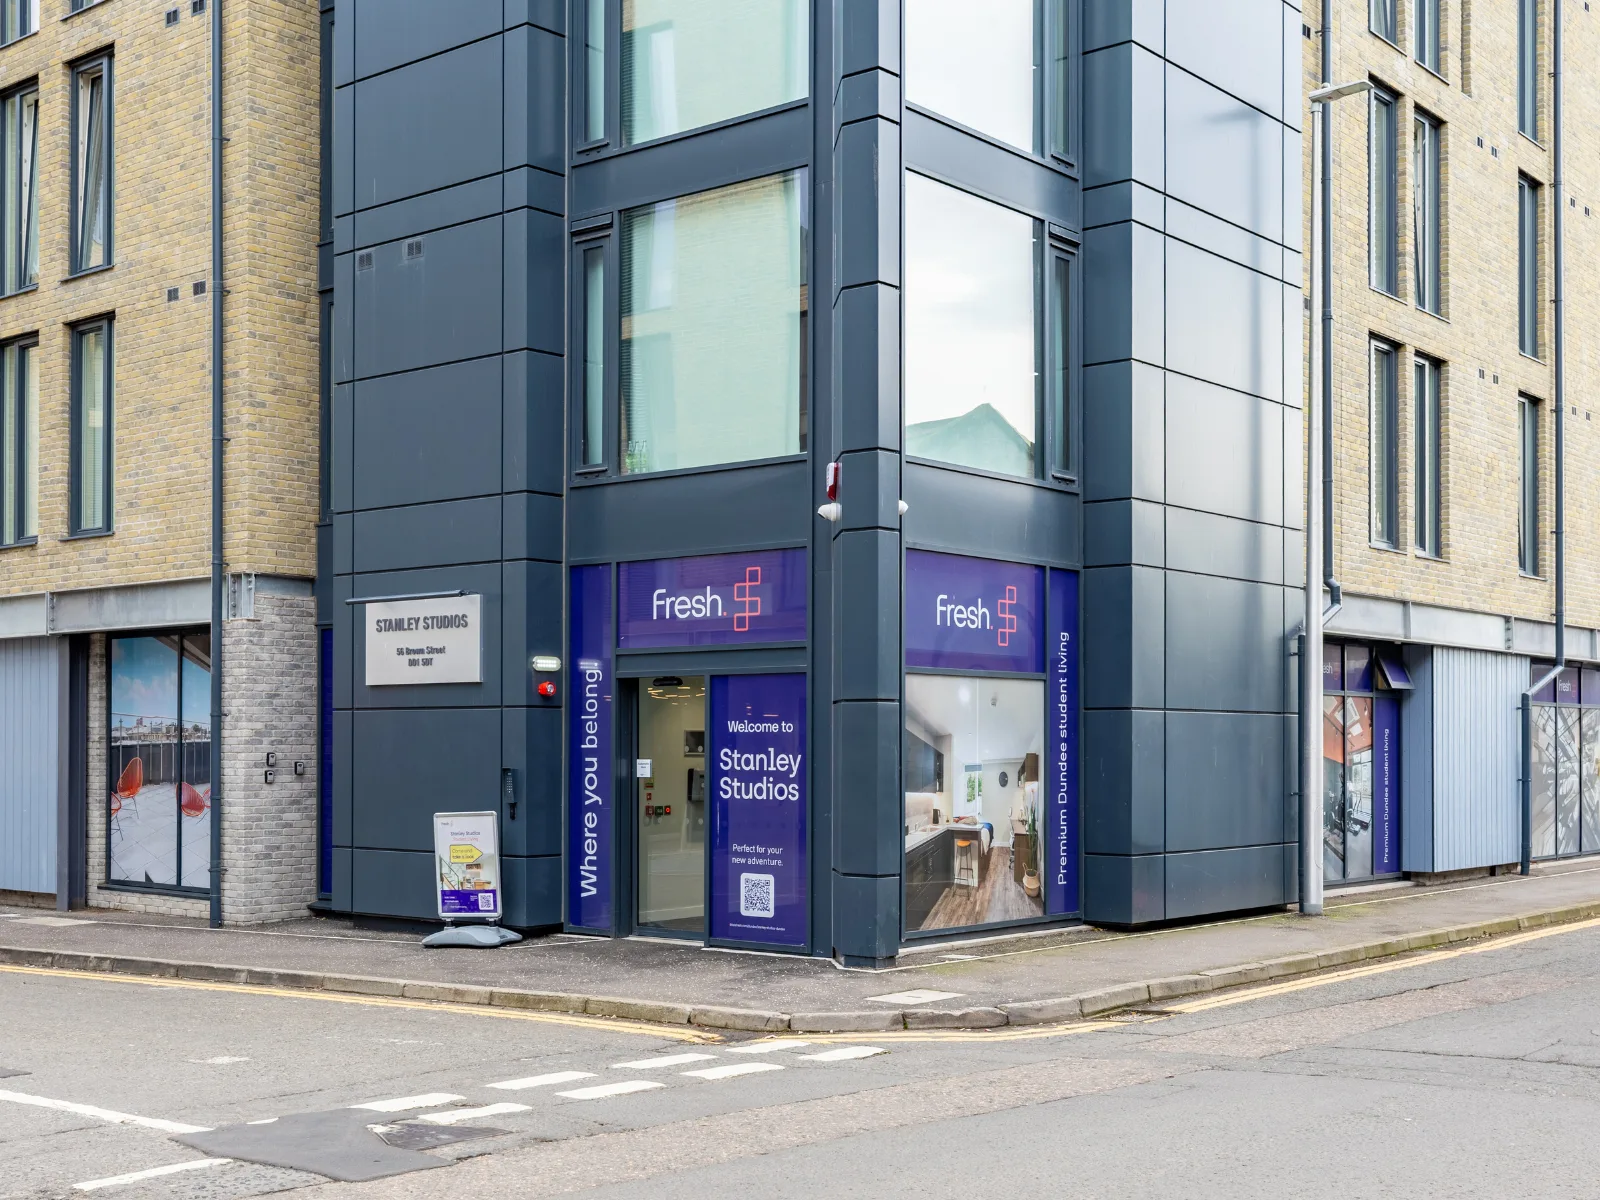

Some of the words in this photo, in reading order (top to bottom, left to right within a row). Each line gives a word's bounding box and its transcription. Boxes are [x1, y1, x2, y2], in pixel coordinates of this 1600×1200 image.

[375, 616, 420, 633] STANLEY
[422, 613, 469, 630] STUDIOS
[396, 647, 405, 656] 56
[426, 646, 446, 655] Street
[408, 658, 420, 667] DD1
[1058, 632, 1070, 673] living
[1058, 677, 1067, 738] student
[728, 720, 779, 732] Welcome
[781, 721, 794, 732] to
[720, 748, 801, 778] Stanley
[1058, 742, 1067, 804] Dundee
[584, 757, 602, 805] you
[720, 776, 799, 801] Studios
[580, 811, 598, 897] Where
[732, 843, 755, 853] Perfect
[756, 845, 766, 854] for
[767, 847, 783, 856] your
[1057, 809, 1067, 885] Premium
[747, 856, 784, 866] adventure.
